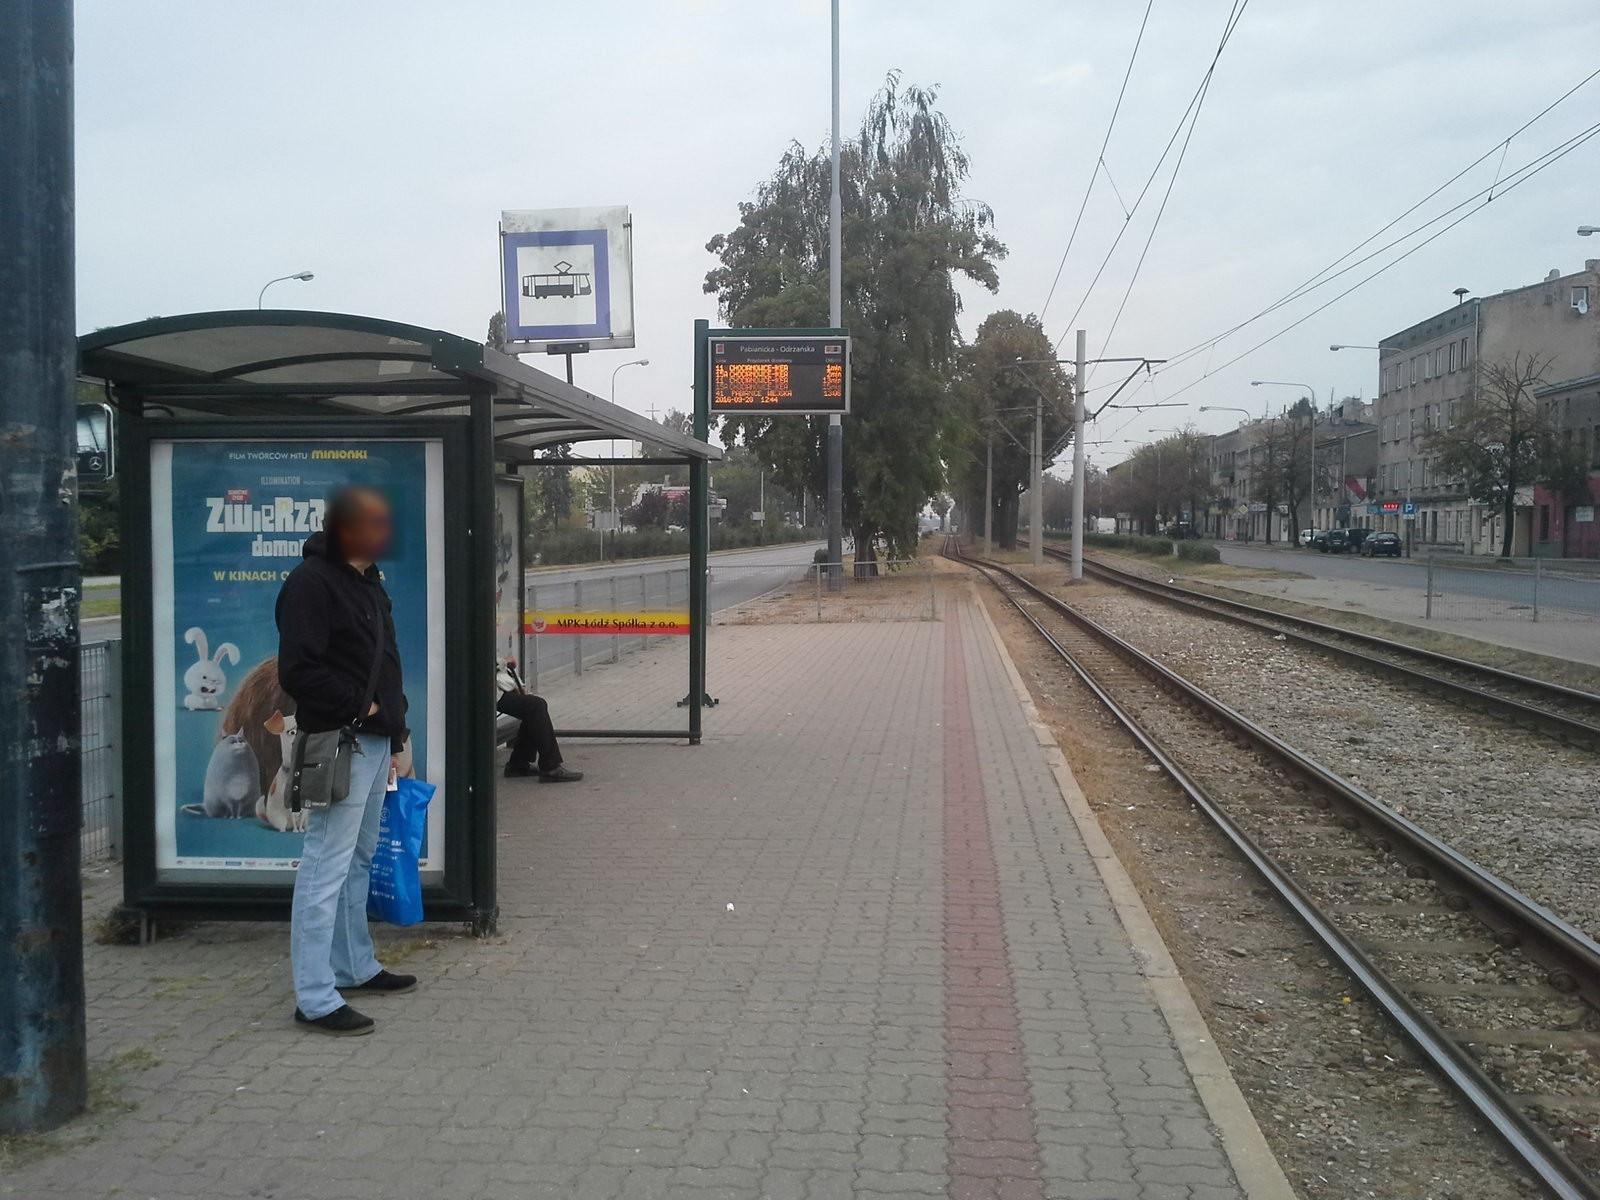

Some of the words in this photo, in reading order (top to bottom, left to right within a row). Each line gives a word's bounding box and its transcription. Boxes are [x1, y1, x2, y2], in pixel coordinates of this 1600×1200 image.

[213, 571, 225, 581] W
[229, 571, 276, 581] KINACH
[557, 618, 609, 629] MPK-Łódź
[612, 618, 646, 630] Spółka
